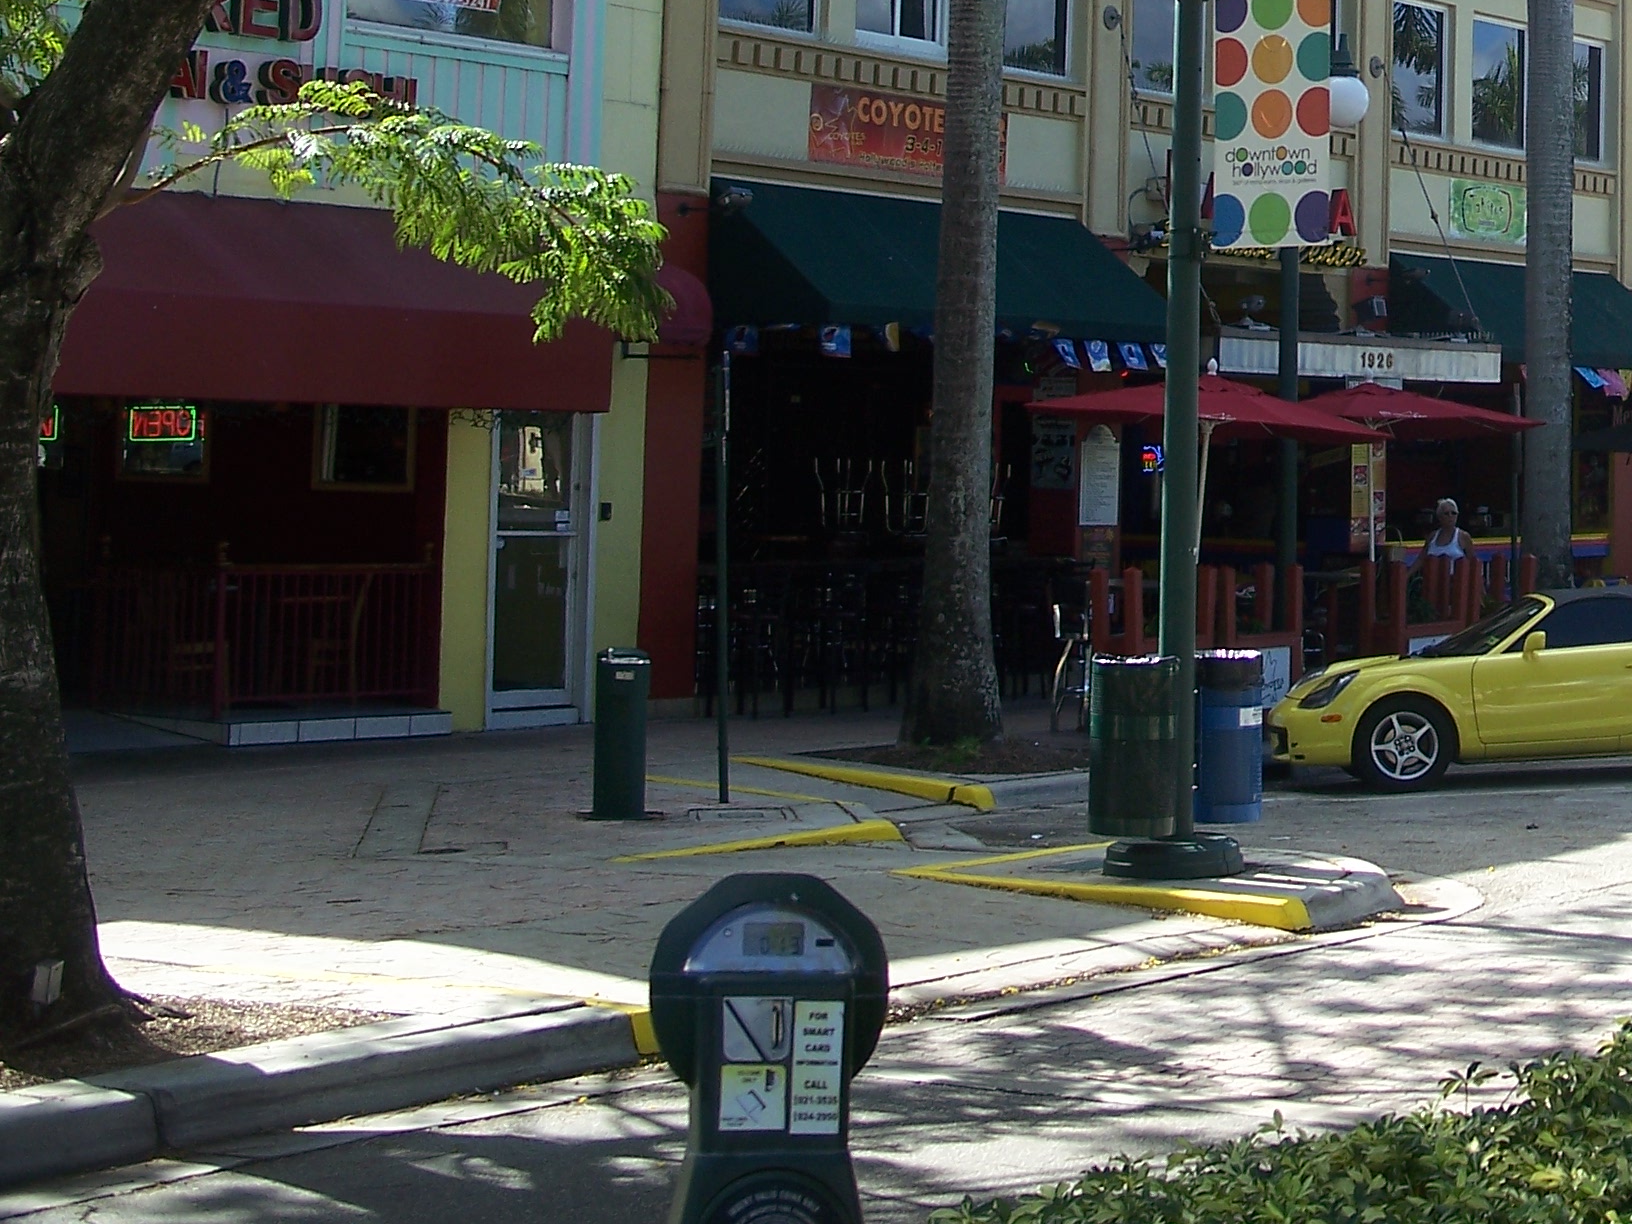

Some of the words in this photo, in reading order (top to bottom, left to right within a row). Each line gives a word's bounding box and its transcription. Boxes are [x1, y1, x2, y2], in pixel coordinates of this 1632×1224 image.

[213, 58, 253, 105] &
[1225, 145, 1311, 163] downtown
[1232, 159, 1317, 180] hollywood
[808, 1011, 829, 1021] FOR
[803, 1026, 836, 1037] SMART
[805, 1043, 831, 1053] CARD
[804, 1079, 828, 1090] CALL
